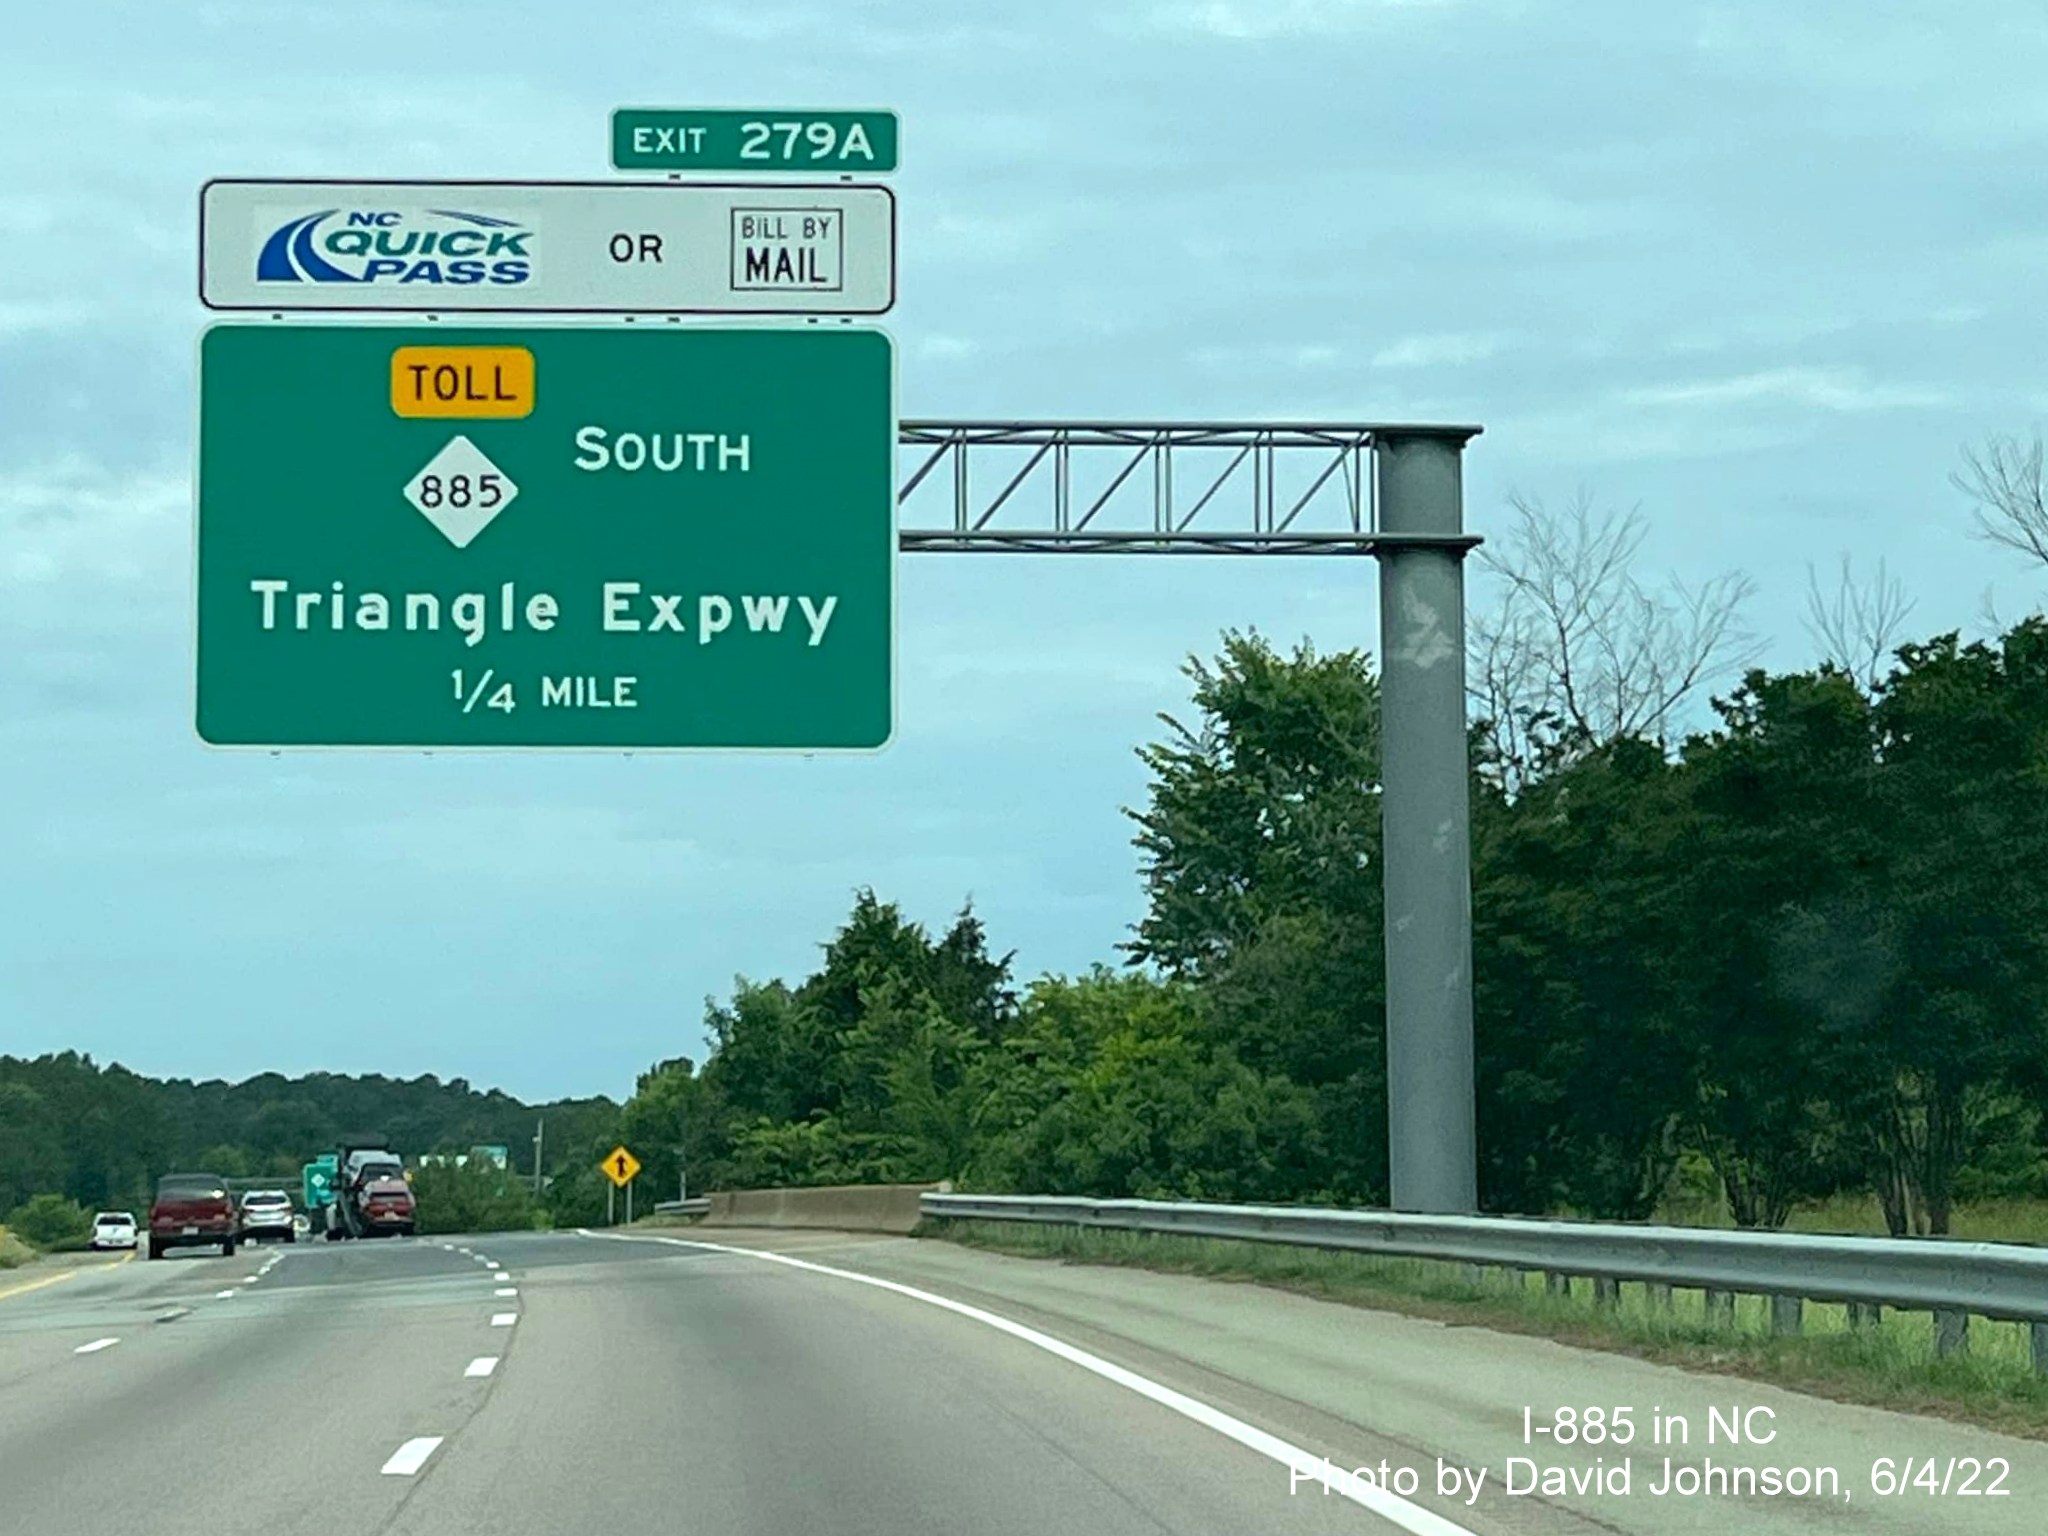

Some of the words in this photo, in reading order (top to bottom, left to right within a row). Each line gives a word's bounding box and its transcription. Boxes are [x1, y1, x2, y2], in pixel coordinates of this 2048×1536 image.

[633, 127, 707, 154] EXIT
[740, 122, 874, 161] 279A
[347, 212, 402, 227] NC
[741, 216, 788, 240] BILL
[802, 216, 832, 240] BY
[325, 230, 534, 257] QUICK
[609, 233, 663, 263] OR
[363, 259, 530, 285] PASS
[745, 246, 828, 283] MAIL
[407, 364, 517, 401] TOLL
[574, 426, 750, 472] SOUTH
[419, 475, 502, 509] 885
[250, 580, 559, 648] Triangle
[603, 582, 838, 646] Expwy
[542, 676, 638, 708] MILE
